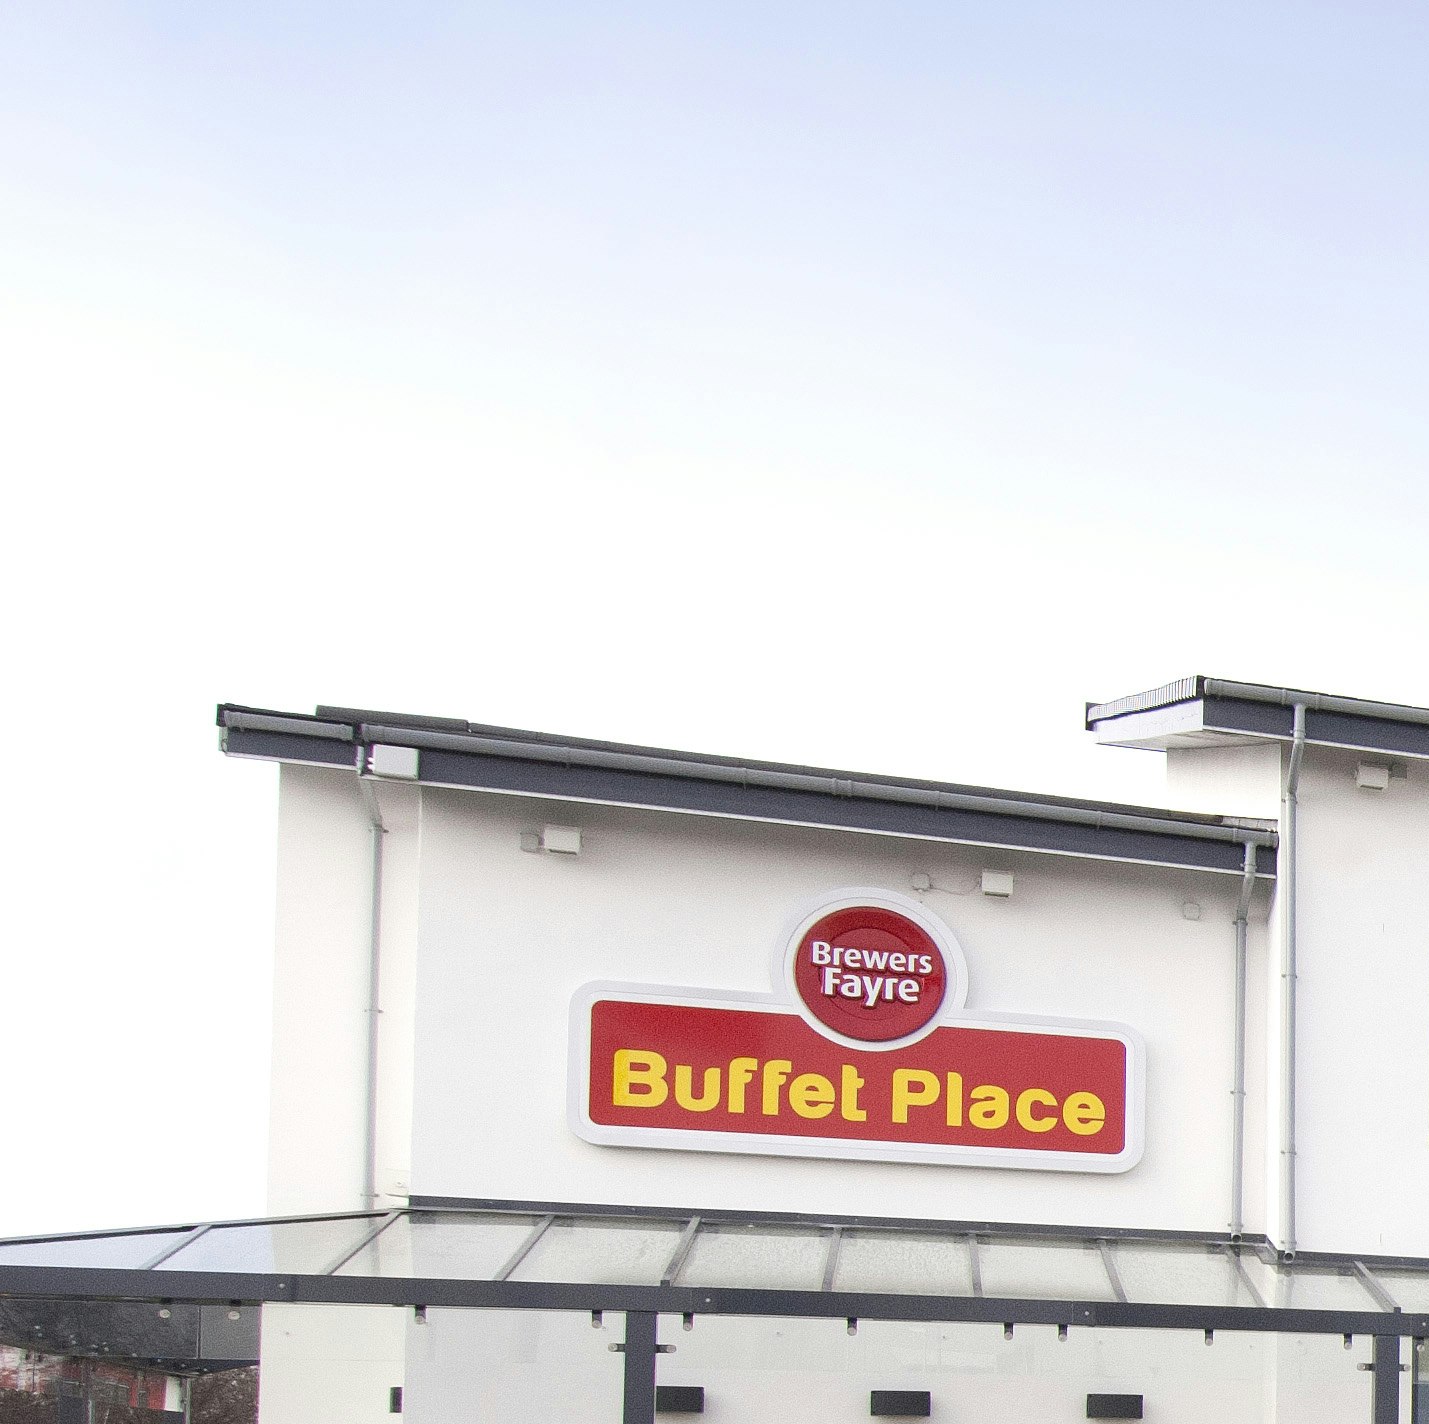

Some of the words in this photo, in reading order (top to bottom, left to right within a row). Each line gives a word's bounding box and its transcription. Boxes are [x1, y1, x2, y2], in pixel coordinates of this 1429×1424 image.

[811, 941, 932, 975] Brewers
[823, 967, 920, 1007] Fayre
[613, 1049, 867, 1122] Buffet
[891, 1068, 1106, 1136] Place
